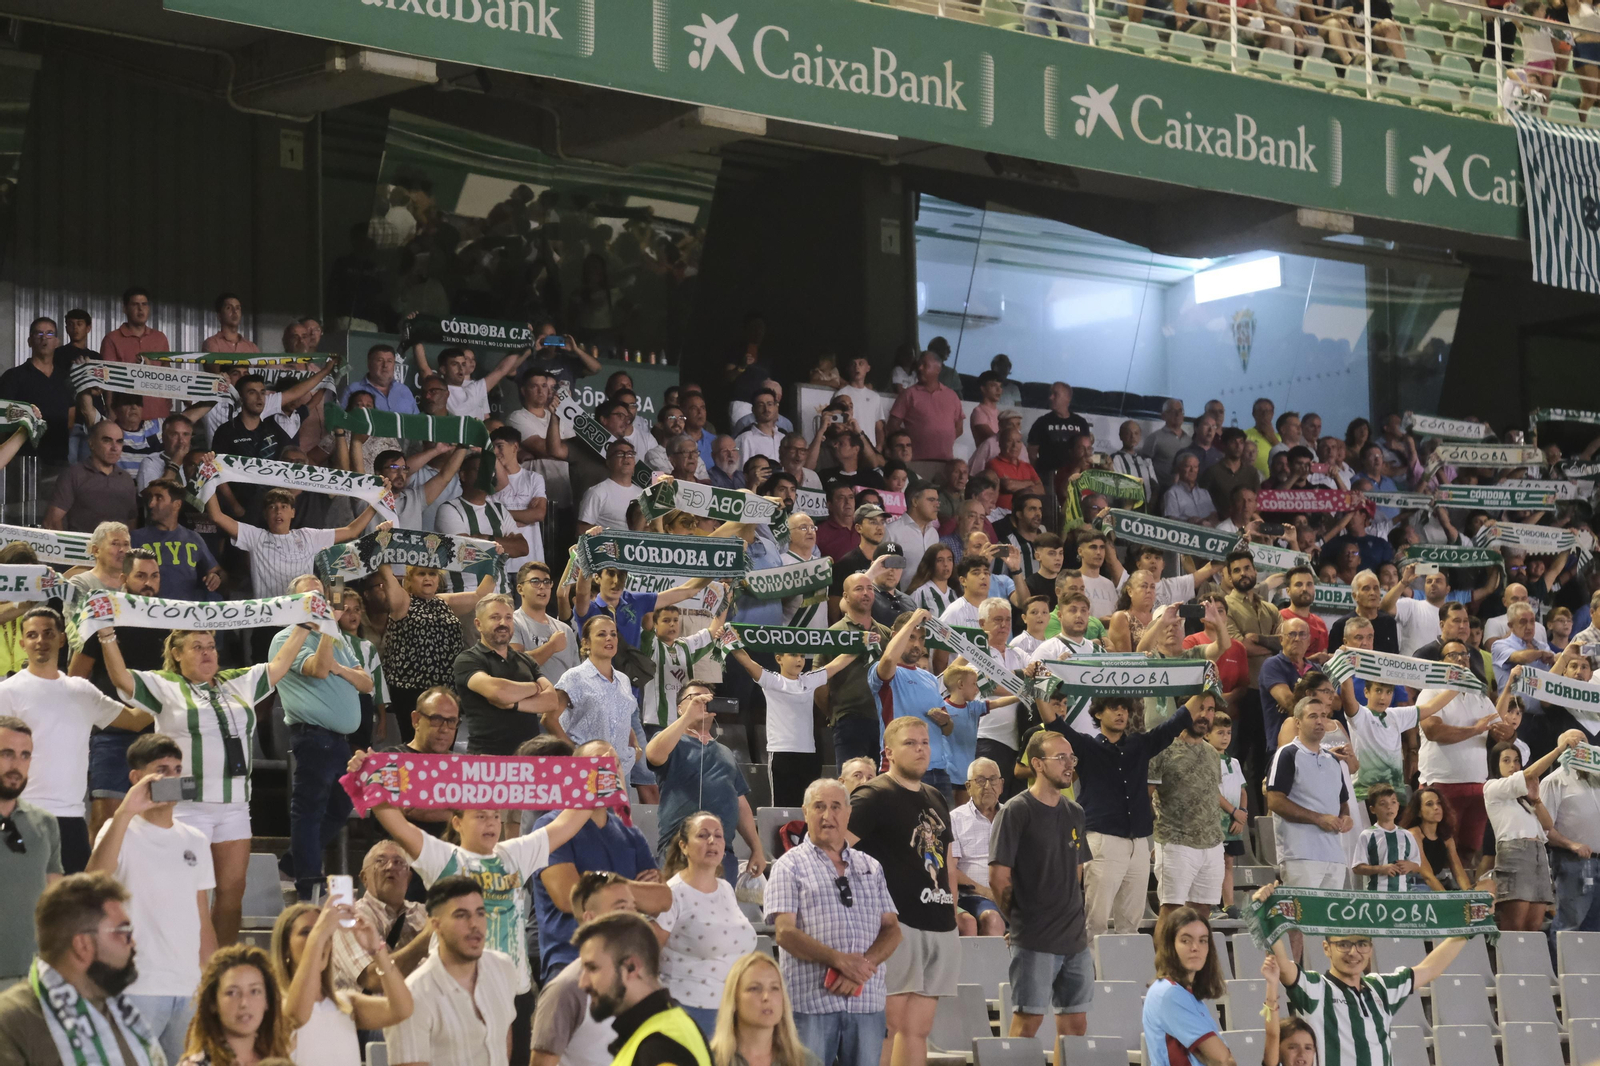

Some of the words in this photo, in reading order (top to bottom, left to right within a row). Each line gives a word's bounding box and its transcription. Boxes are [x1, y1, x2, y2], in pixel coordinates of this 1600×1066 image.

[753, 25, 967, 111] CaixaBank
[1131, 94, 1318, 173] CaixaBank
[441, 317, 507, 339] CÓRDOBA
[130, 368, 178, 383] CÓRDOBA
[180, 375, 193, 384] CF
[140, 381, 165, 391] DESDE
[1048, 424, 1081, 432] REACH
[1420, 418, 1481, 435] CÓRDOBA
[1441, 447, 1508, 463] CÓRDOBA
[1274, 491, 1317, 501] MUJER
[1262, 499, 1334, 511] CORDOBESA
[392, 532, 424, 547] C.F.
[1120, 518, 1202, 549] CÓRDOBA
[1205, 537, 1229, 554] CF
[1515, 528, 1550, 540] CÓRDOBA
[1551, 532, 1560, 541] CF
[141, 541, 198, 567] NYC
[623, 540, 709, 567] CÓRDOBA
[713, 550, 737, 568] CF
[1420, 547, 1490, 562] CÓRDOBA
[743, 626, 835, 646] CÓRDOBA
[837, 631, 860, 646] CF
[965, 645, 996, 670] CÓRDOBA
[996, 668, 1006, 677] CF
[1377, 656, 1418, 672] CÓRDOBA
[1418, 664, 1429, 673] CF
[1079, 668, 1169, 686] CÓRDOBA
[1386, 669, 1406, 679] DESDE
[1406, 671, 1421, 682] 1954
[461, 762, 535, 783] MUJER
[433, 783, 563, 804] CORDOBESA
[1327, 898, 1438, 924] CÓRDOBA
